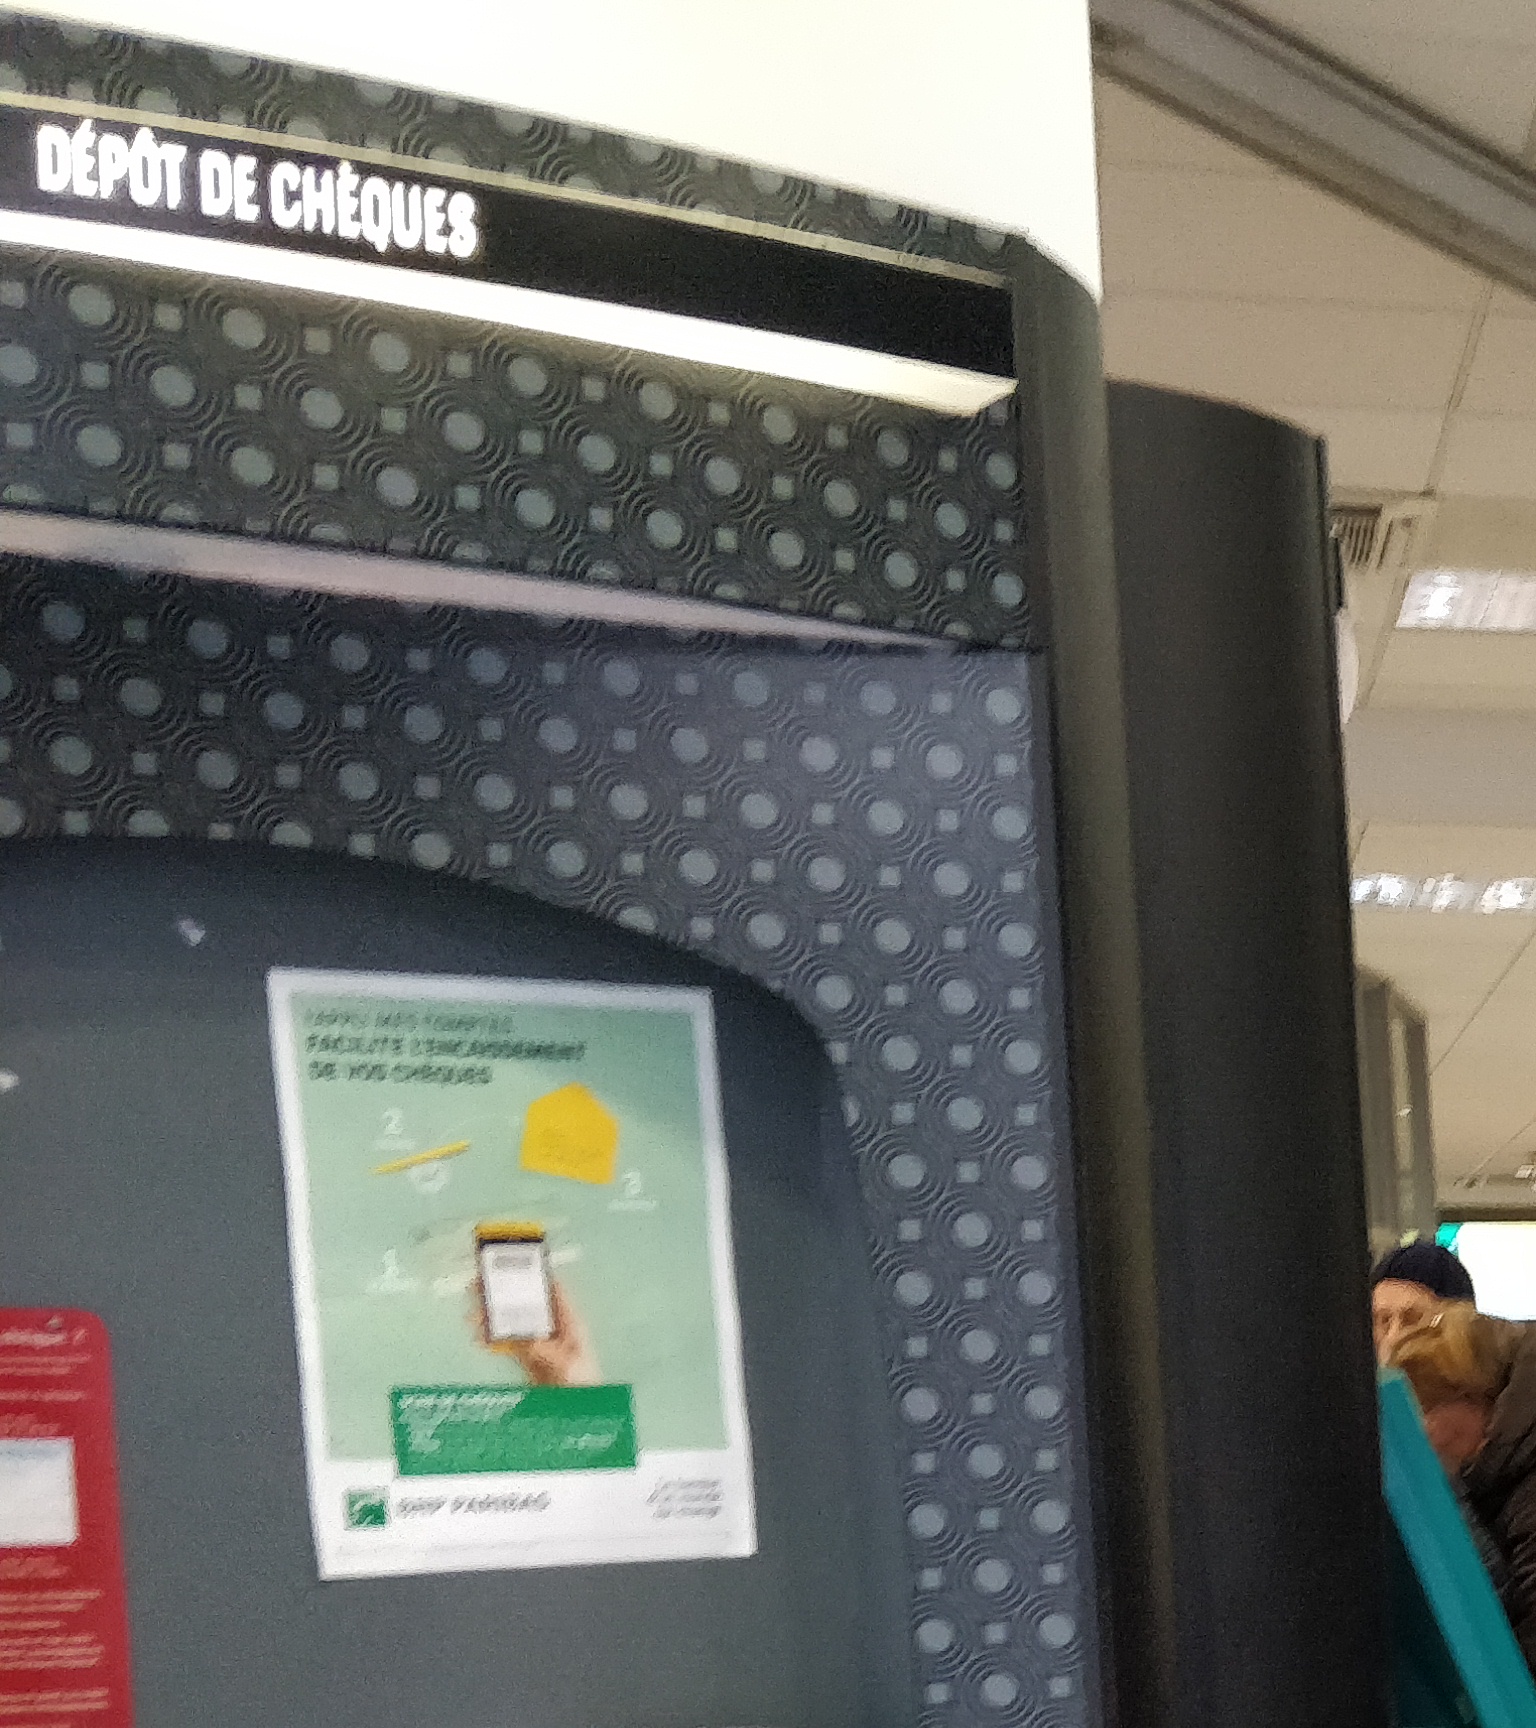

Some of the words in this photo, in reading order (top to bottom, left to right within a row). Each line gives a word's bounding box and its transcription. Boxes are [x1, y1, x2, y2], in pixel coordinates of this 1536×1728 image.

[36, 118, 188, 211] DÉPÔT
[199, 148, 262, 223] DE
[268, 160, 480, 260] CHÈQUES
